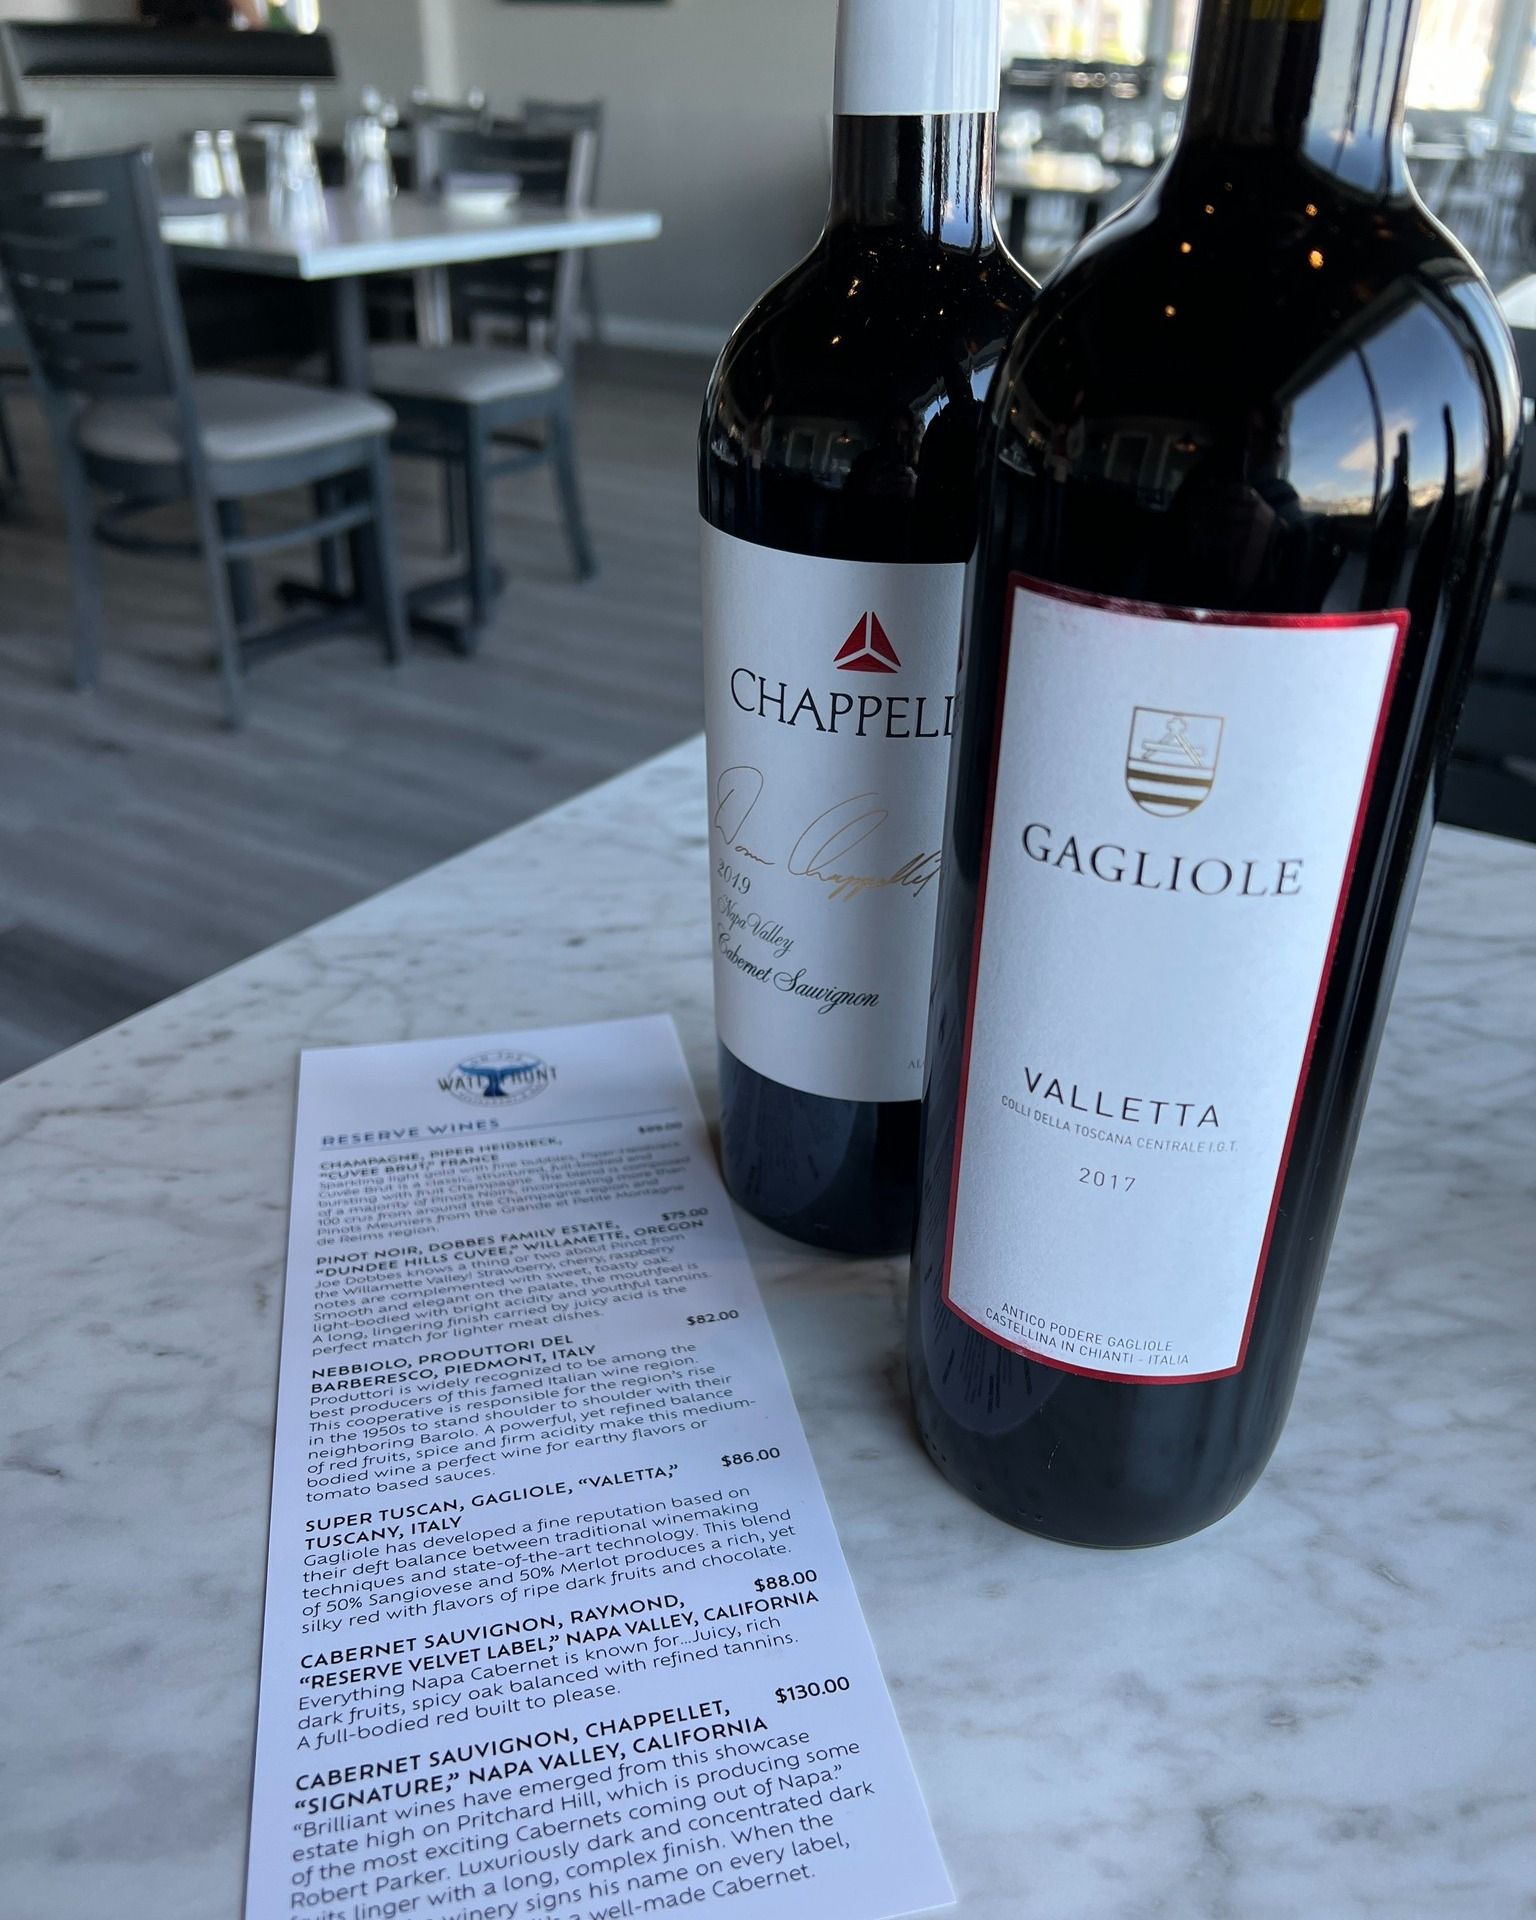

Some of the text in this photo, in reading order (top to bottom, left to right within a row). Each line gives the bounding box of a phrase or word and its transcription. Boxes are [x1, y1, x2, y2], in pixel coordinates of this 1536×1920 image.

[717, 858, 751, 894] 2019
[1022, 823, 1303, 897] GAGLIOLE
[718, 894, 794, 958] Napa Valley
[717, 922, 879, 1015] Cabernet Sauvignon
[1001, 1095, 1238, 1153] COLLI DELLA TOSCANA CENTRALE I.G.T.
[1024, 1067, 1219, 1128] VALLETTA
[320, 1117, 500, 1147] RESERVE WINES
[1079, 1167, 1136, 1192] 2017
[403, 1252, 449, 1268] HILLS
[632, 1219, 704, 1237] OREGON
[660, 1207, 709, 1222] $75.00
[315, 1250, 369, 1267] PINOT
[427, 1234, 496, 1253] DOBBES
[499, 1227, 556, 1244] FAMILY
[685, 1309, 739, 1327] $82.00
[985, 1307, 1057, 1348] CASTELLINA
[1061, 1340, 1075, 1354] IN
[1079, 1345, 1134, 1364] CHIANTI
[1148, 1354, 1189, 1366] ITALIA
[1001, 1302, 1173, 1352] ANTICO PODERE GAGLIOLE
[310, 1344, 596, 1394] BARBERESCO, PIEDMONT, ITALY
[311, 1334, 574, 1380] NEBBIOLO, PRODUTTORI DEL
[305, 1467, 496, 1503] tomato based sauces.
[720, 1446, 781, 1468] $86.00
[303, 1487, 750, 1567] Gagliole has developed a fine reputation based on
[304, 1463, 678, 1533] SUPER TUSCAN, GAGLIOLE, “VALETTA,”
[301, 1508, 791, 1600] techniques and state-of-the-art technology. This blend
[302, 1501, 759, 1584] their deft balance between traditional winemaking
[304, 1514, 462, 1551] TUSCANY, ITALY
[301, 1524, 796, 1618] of 50% Sangiovese and 50% Merlot produces a rich, yet
[301, 1544, 792, 1634] silky red with flavors of ripe dark fruits and chocolate.
[753, 1568, 818, 1593] $88.00
[299, 1589, 820, 1690] “RESERVE VELVET LABEL,” NAPA VALLEY, CALIFORNIA
[300, 1593, 685, 1669] CABERNET SAUVIGNON, RAYMOND,
[297, 1633, 799, 1730] dark fruits, spicy oak balanced with refined tannins.
[298, 1682, 405, 1711] Everything
[411, 1672, 465, 1692] Napa
[470, 1654, 560, 1681] Cabernet
[564, 1651, 579, 1665] is
[584, 1640, 648, 1662] known
[745, 1615, 781, 1633] rich
[774, 1675, 850, 1705] $130.00
[295, 1699, 730, 1791] CABERNET SAUVIGNON, CHAPPELLET,
[296, 1683, 621, 1751] A full-bodied red built to please.
[293, 1731, 810, 1839] “Brilliant wines have emerged from this showcase
[294, 1715, 769, 1815] “SIGNATURE,” NAPA VALLEY, CALIFORNIA
